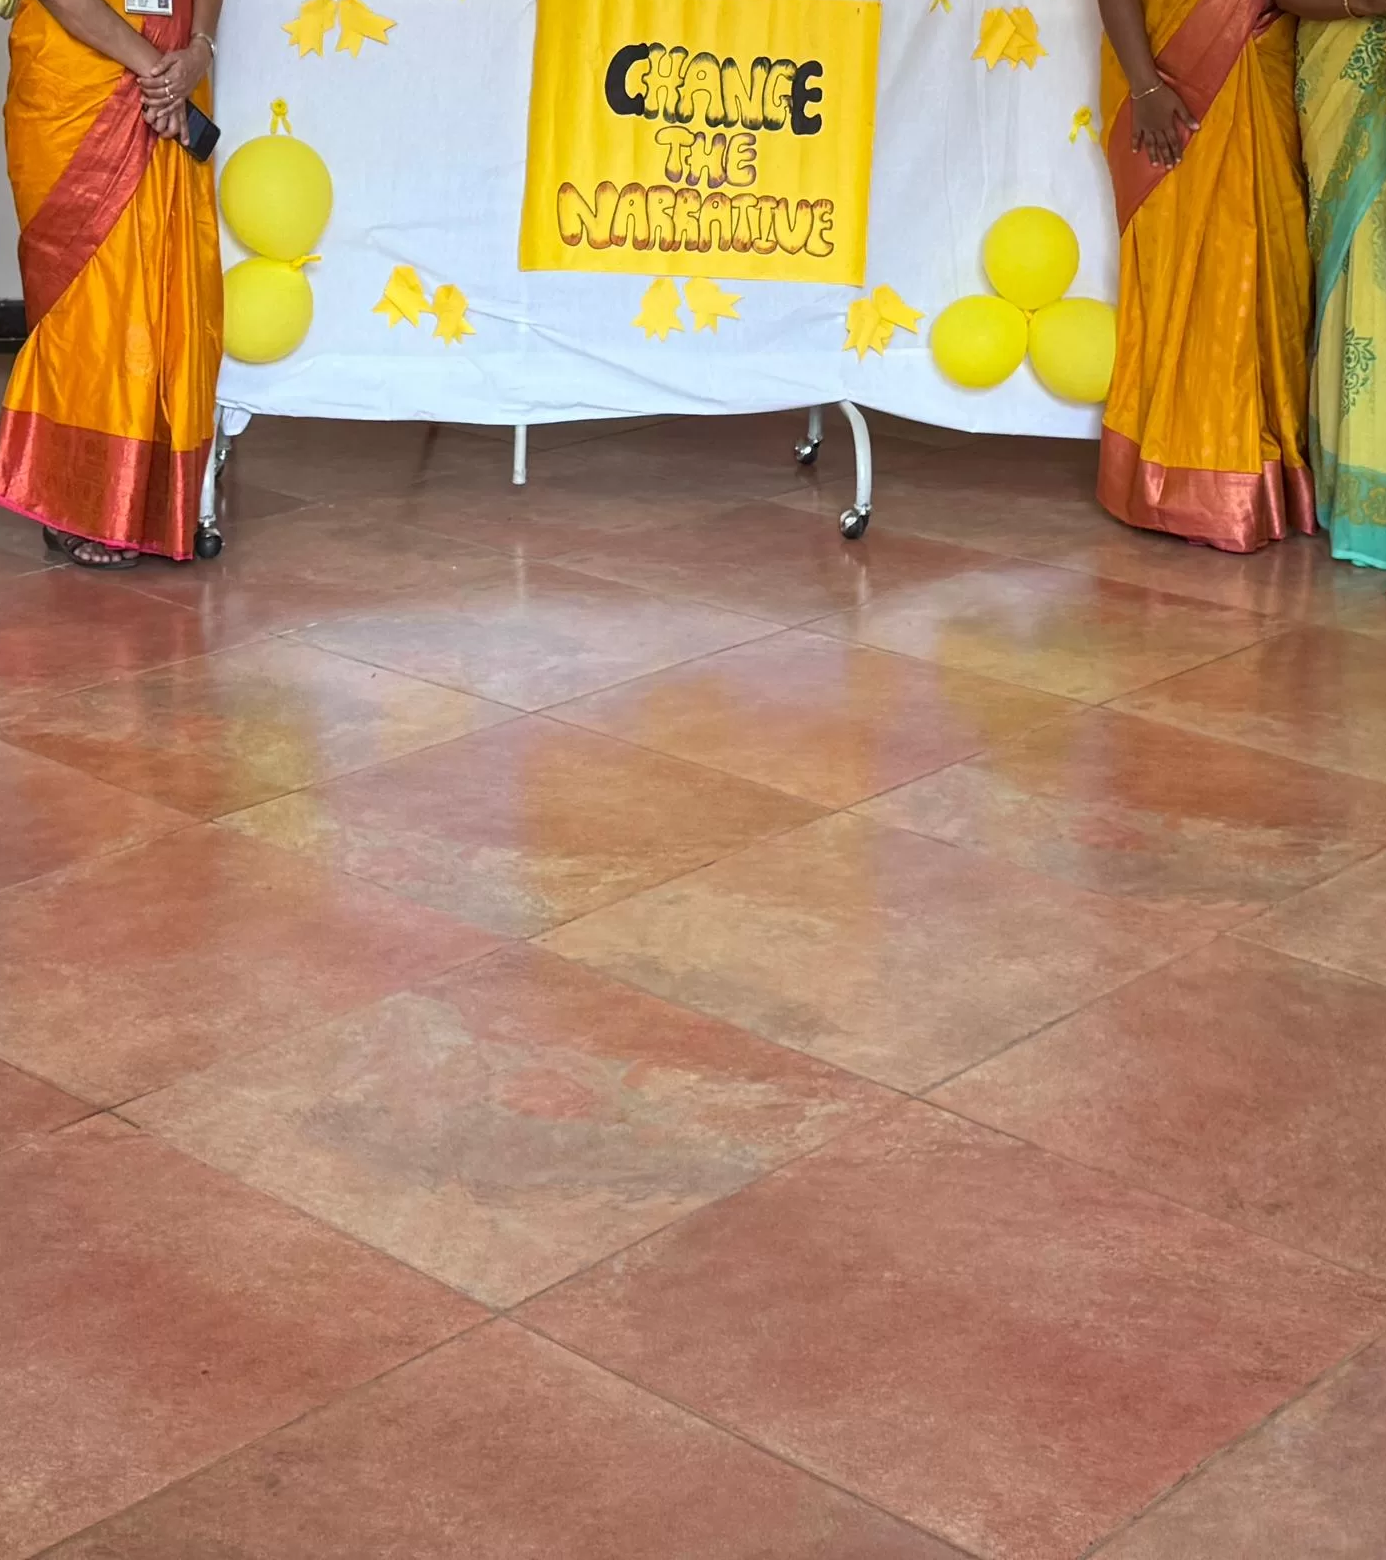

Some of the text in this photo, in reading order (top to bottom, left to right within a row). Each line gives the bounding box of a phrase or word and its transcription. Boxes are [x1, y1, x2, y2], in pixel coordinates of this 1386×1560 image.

[604, 42, 824, 135] CHANGE
[655, 126, 757, 188] THE
[557, 180, 835, 258] NARRATIVE
